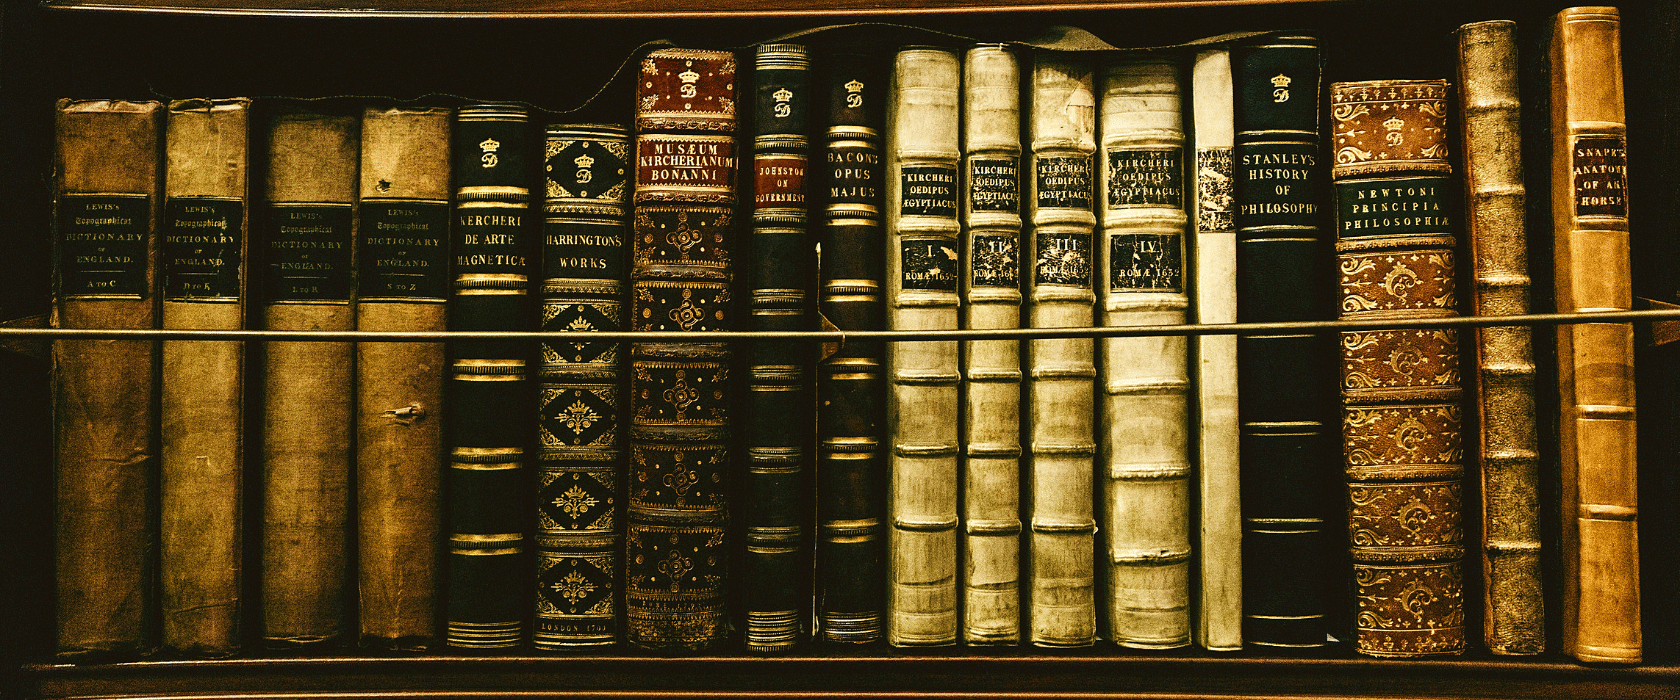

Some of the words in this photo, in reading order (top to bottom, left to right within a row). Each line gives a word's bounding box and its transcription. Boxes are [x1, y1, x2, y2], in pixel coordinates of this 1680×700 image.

[654, 144, 718, 155] MUSÆUM
[640, 155, 733, 168] KIRCHERIANUM
[1117, 159, 1175, 168] KIRCHERI
[1242, 153, 1316, 166] STANLEY'S
[651, 169, 717, 181] BONANNI
[760, 167, 804, 176] JOHNSTON
[834, 168, 871, 180] OPUS
[1122, 172, 1172, 181] OEDIPUS
[1249, 168, 1309, 180] HISTORY
[907, 173, 953, 183] KIRCHERI
[1045, 177, 1086, 186] OEDIPUS
[777, 179, 788, 188] ON
[1583, 180, 1599, 189] OF
[1606, 180, 1621, 189] AN
[830, 187, 875, 198] MAJUS
[910, 186, 949, 195] OEDIPUS
[1275, 185, 1291, 196] OF
[1357, 187, 1435, 200] NEWTONI
[755, 193, 805, 202] GOVERNMENT
[1580, 196, 1622, 206] HORSE
[902, 199, 957, 209] ÆGYPTIACUS
[1241, 203, 1318, 215] PHILOSOPHY
[1352, 201, 1440, 214] PRINCIPIA
[75, 217, 132, 227] Topographical
[460, 215, 521, 227] KERCHERI
[66, 233, 143, 241] DICTIONARY
[166, 235, 234, 243] DICTIONARY
[367, 237, 440, 247] DICTIONARY
[464, 233, 479, 245] DE
[483, 233, 515, 245] ARTE
[271, 241, 343, 249] DICTIONARY
[1056, 239, 1077, 251] III
[76, 255, 134, 263] ENGLAND.
[174, 258, 225, 266] ENGLAND.
[376, 259, 430, 267] ENGLAND.
[559, 257, 607, 269] WORKS
[281, 262, 333, 270] ENGLAND.
[409, 283, 416, 291] Z
[541, 622, 578, 632] LONDON
